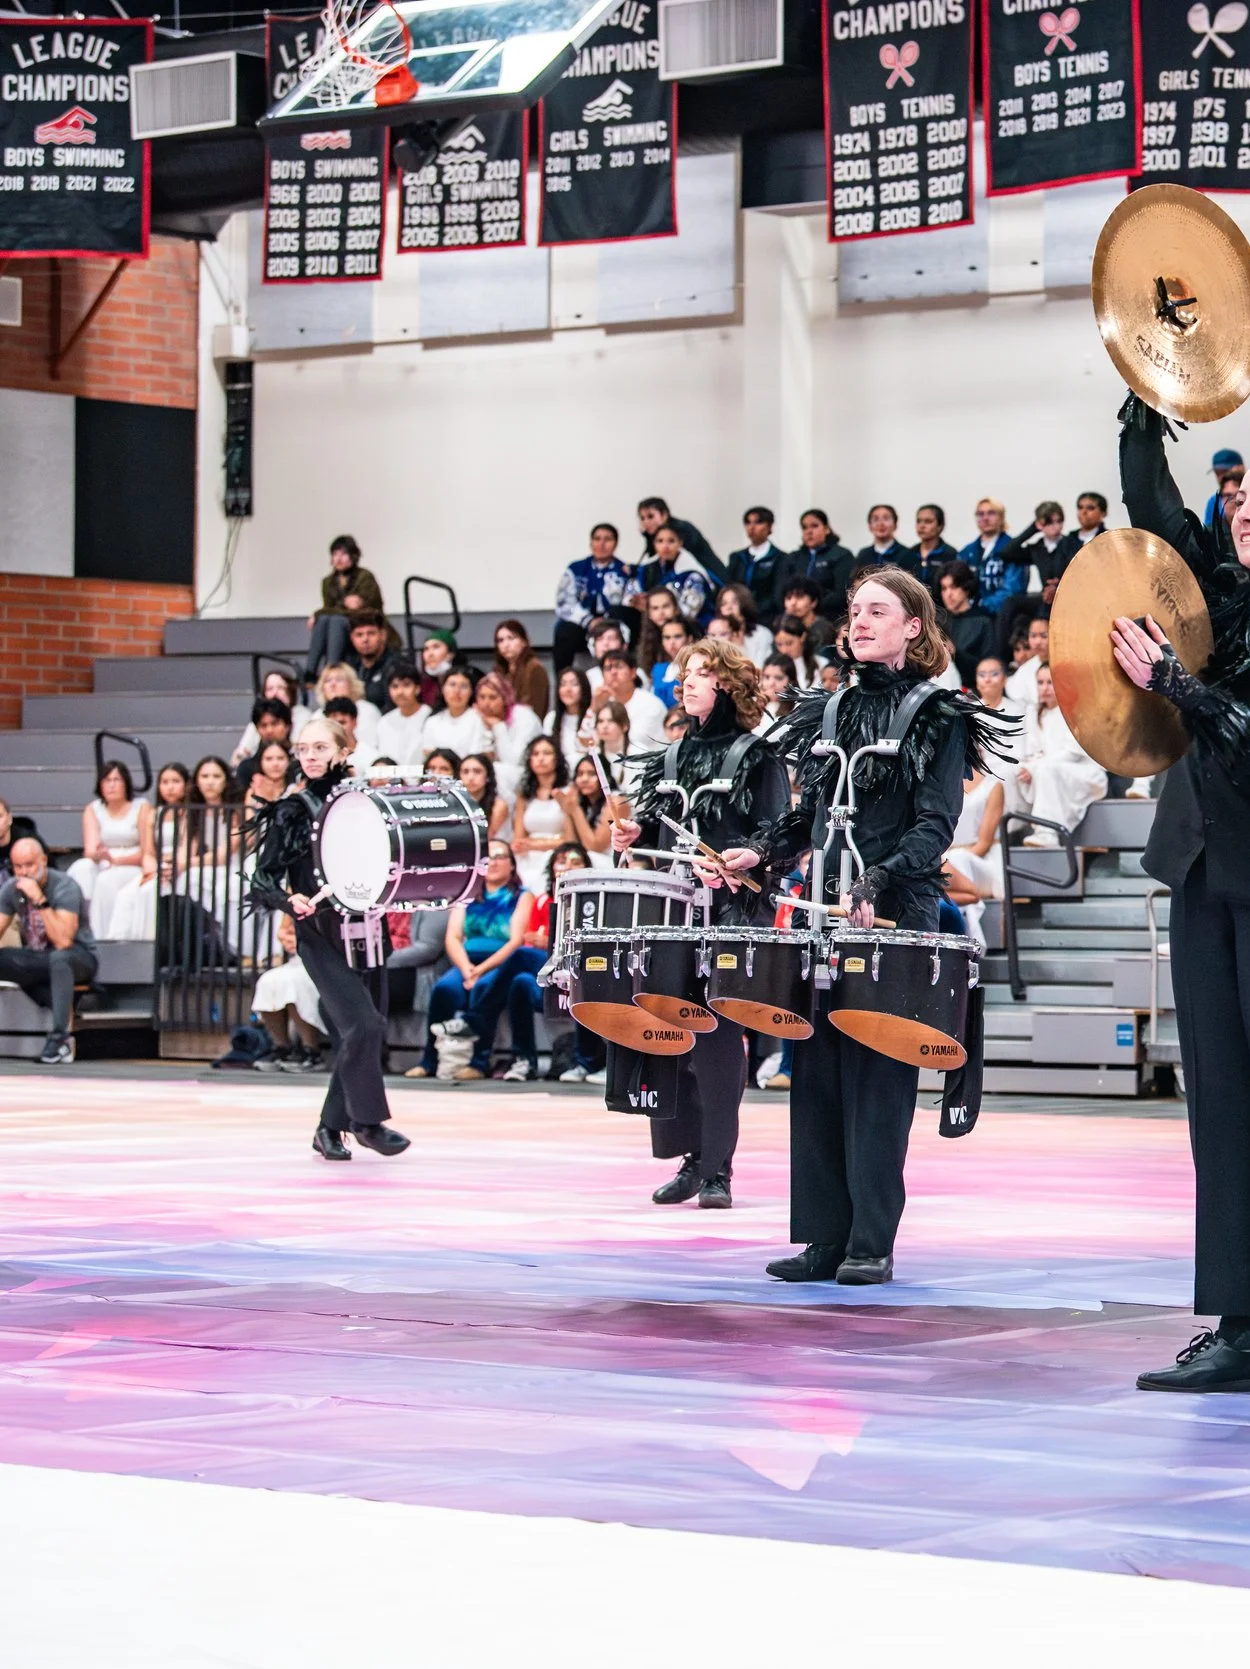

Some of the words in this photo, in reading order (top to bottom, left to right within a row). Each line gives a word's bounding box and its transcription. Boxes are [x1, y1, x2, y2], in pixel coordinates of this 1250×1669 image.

[602, 1, 652, 34] GUE
[833, 0, 965, 40] CHAMPIONS
[12, 32, 120, 70] LEAGUE
[561, 39, 660, 78] HAMPIONS
[1014, 61, 1051, 87] BOYS
[1058, 50, 1109, 79] TENNIS
[1158, 70, 1200, 91] GIRLS
[3, 74, 129, 102] CHAMPIONS
[850, 102, 886, 127] BOYS
[901, 94, 955, 119] TENNIS
[1143, 102, 1177, 122] 1974
[878, 125, 918, 150] 1978
[4, 147, 45, 167] BOYS
[52, 148, 125, 168] SWIMMING
[271, 160, 305, 179] BOYS
[314, 157, 378, 179] SWIMMING
[485, 159, 520, 180] 2010
[834, 159, 871, 182] 2001
[878, 153, 919, 177] 2002
[927, 145, 966, 171] 2003
[30, 175, 60, 191] 2019
[65, 175, 97, 191] 2021
[103, 176, 135, 192] 2022
[833, 187, 875, 210] 2004
[880, 180, 920, 205] 2006
[927, 172, 965, 199] 2007
[834, 212, 875, 236] 2008
[880, 207, 920, 231] 2009
[927, 200, 963, 224] 2010
[344, 254, 377, 275] 2011
[784, 1013, 808, 1025] YAM
[655, 1030, 684, 1042] YAMAHA
[931, 1045, 958, 1056] YAMAHA
